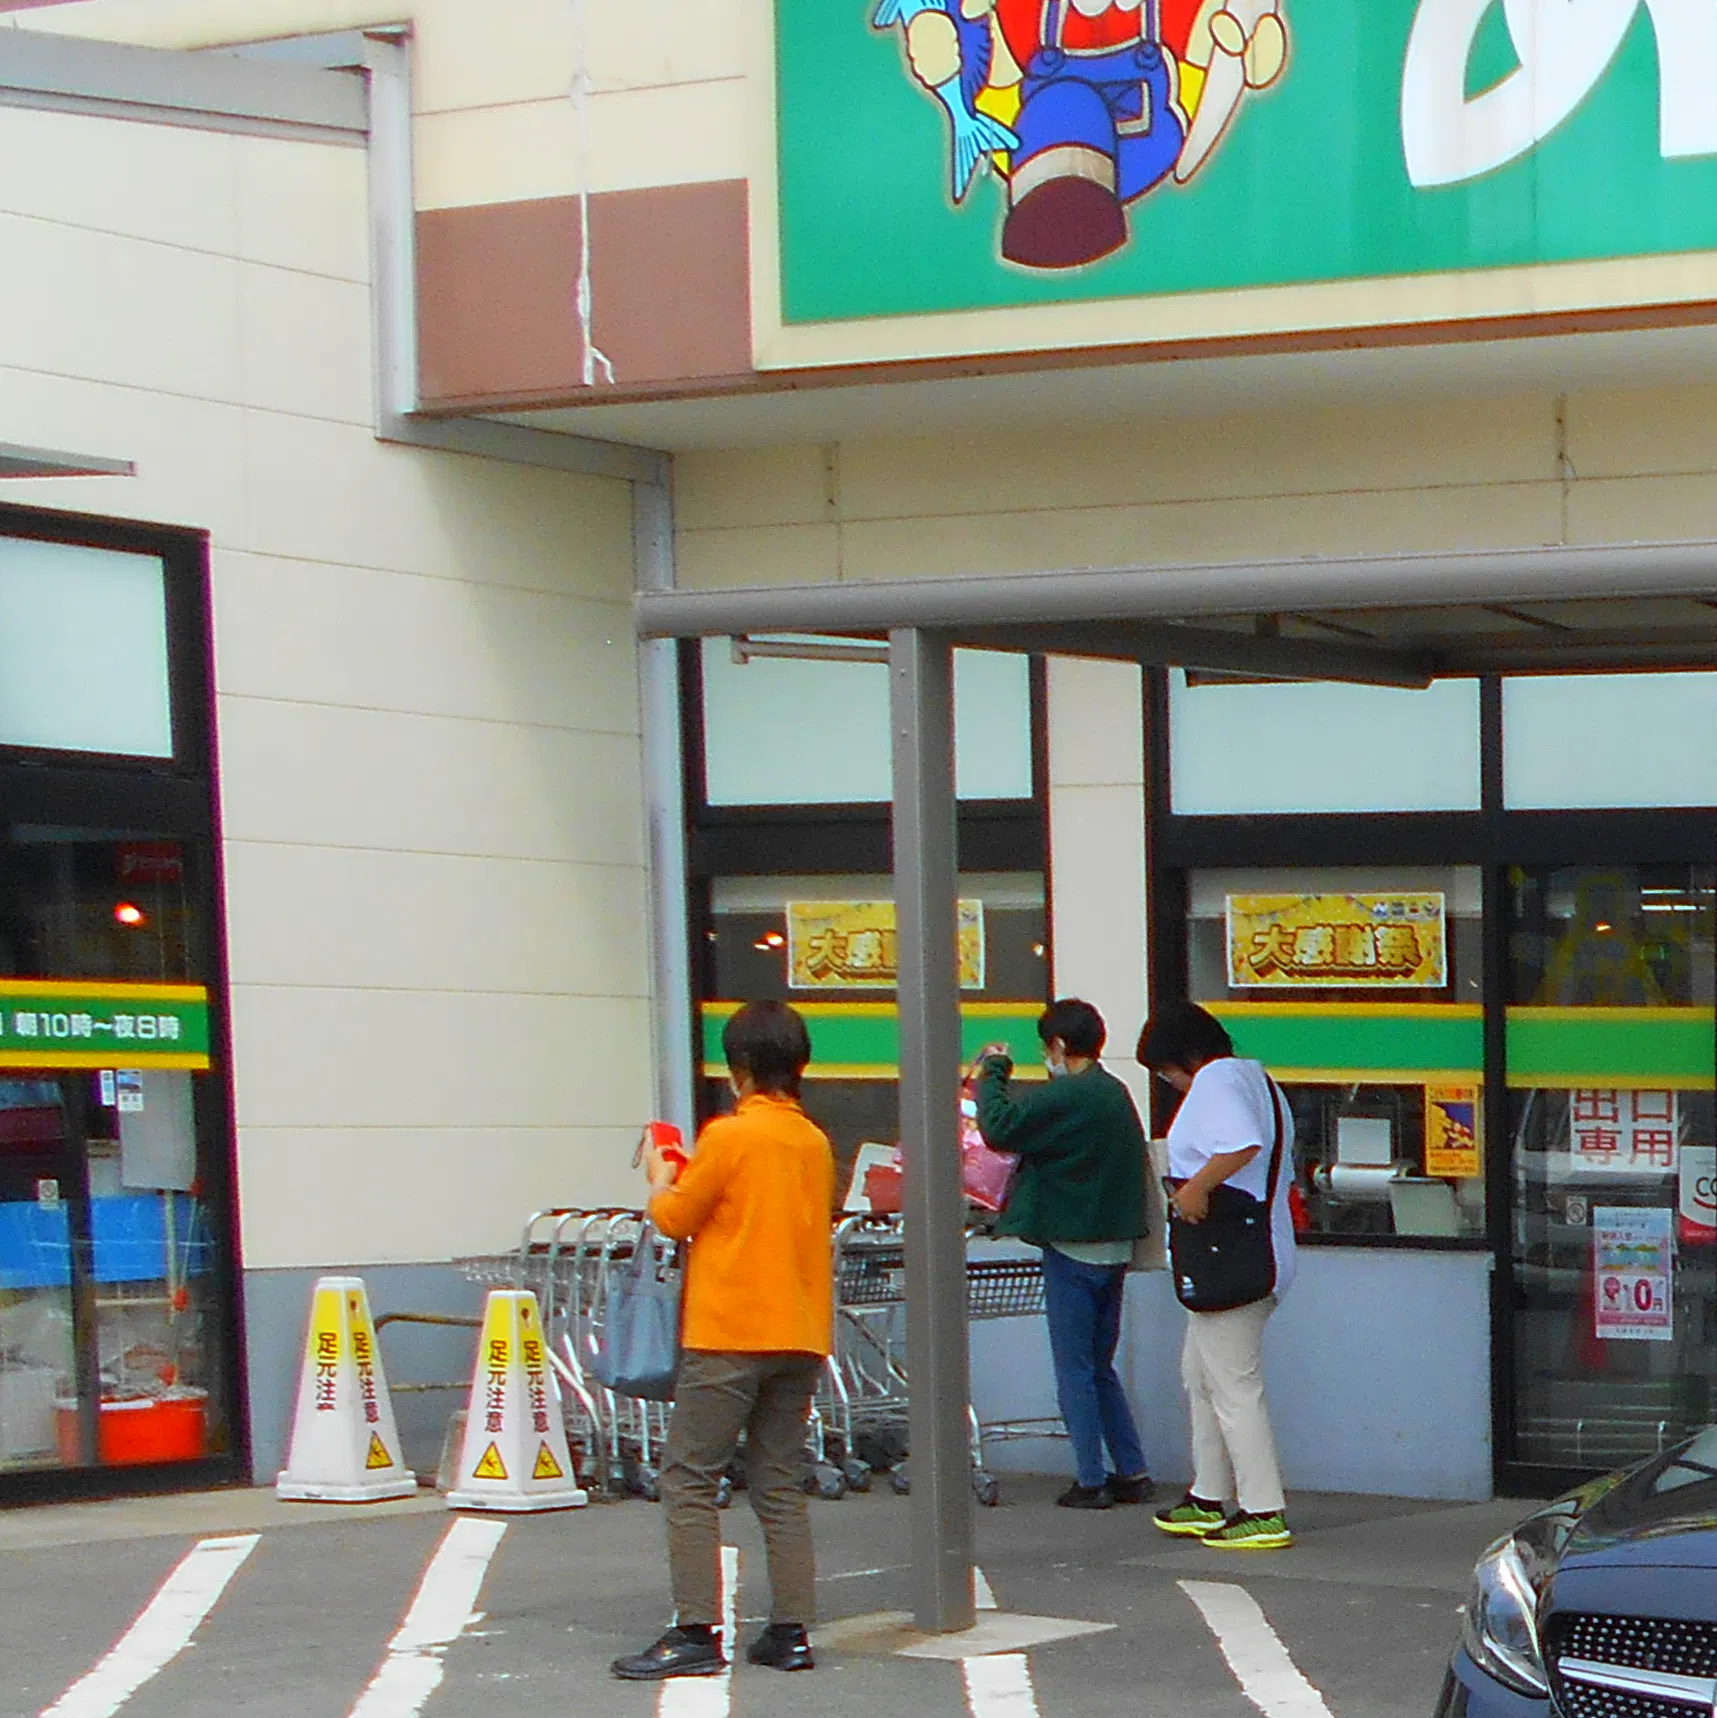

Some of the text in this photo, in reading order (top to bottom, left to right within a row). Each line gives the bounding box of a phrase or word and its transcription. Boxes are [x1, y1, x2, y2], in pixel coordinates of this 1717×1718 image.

[1249, 923, 1422, 970] 大感謝祭
[1574, 1089, 1673, 1123] 出口
[1574, 1126, 1673, 1166] 専用
[353, 1332, 379, 1423] 足元注意
[484, 1340, 507, 1433] 足元注意
[523, 1341, 550, 1433] 足元注意
